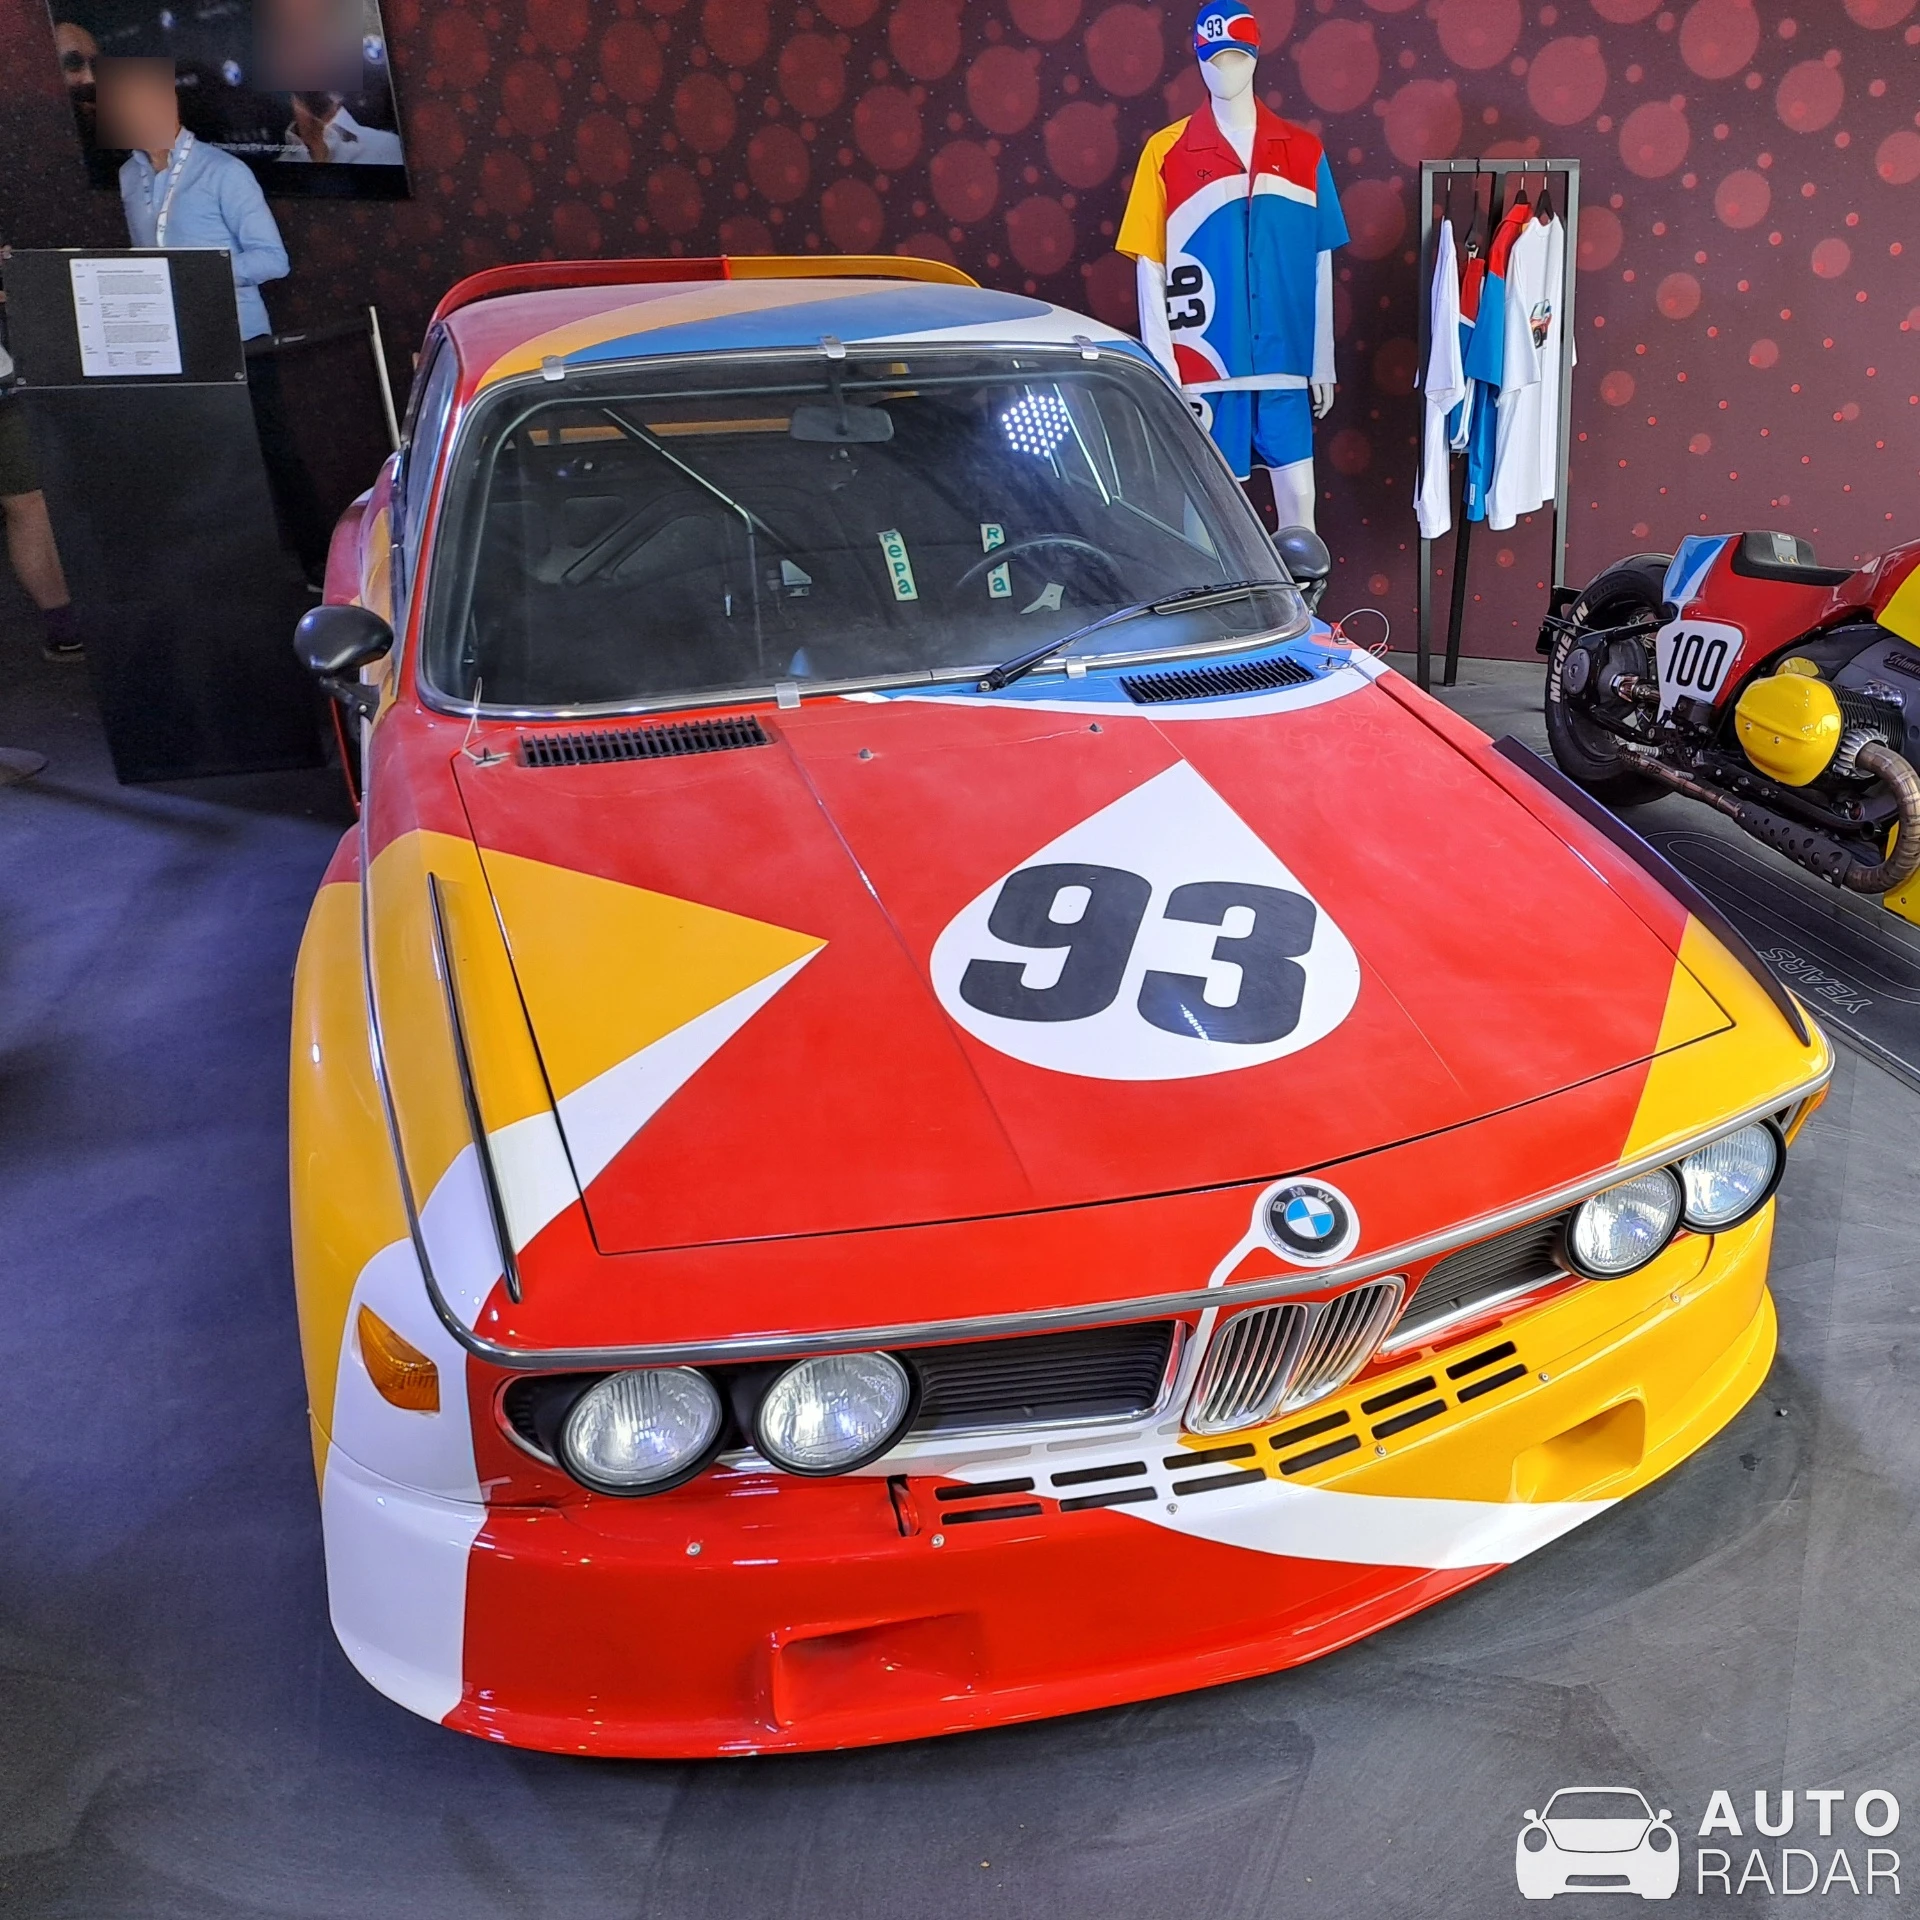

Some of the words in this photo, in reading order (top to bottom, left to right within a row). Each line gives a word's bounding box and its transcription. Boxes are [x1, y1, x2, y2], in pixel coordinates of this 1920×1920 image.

[1206, 18, 1224, 39] 93
[1166, 264, 1207, 332] 93
[1665, 631, 1729, 693] 100
[959, 863, 1318, 1045] 93
[1757, 947, 1874, 1015] YEARS
[1271, 1186, 1334, 1214] BMW
